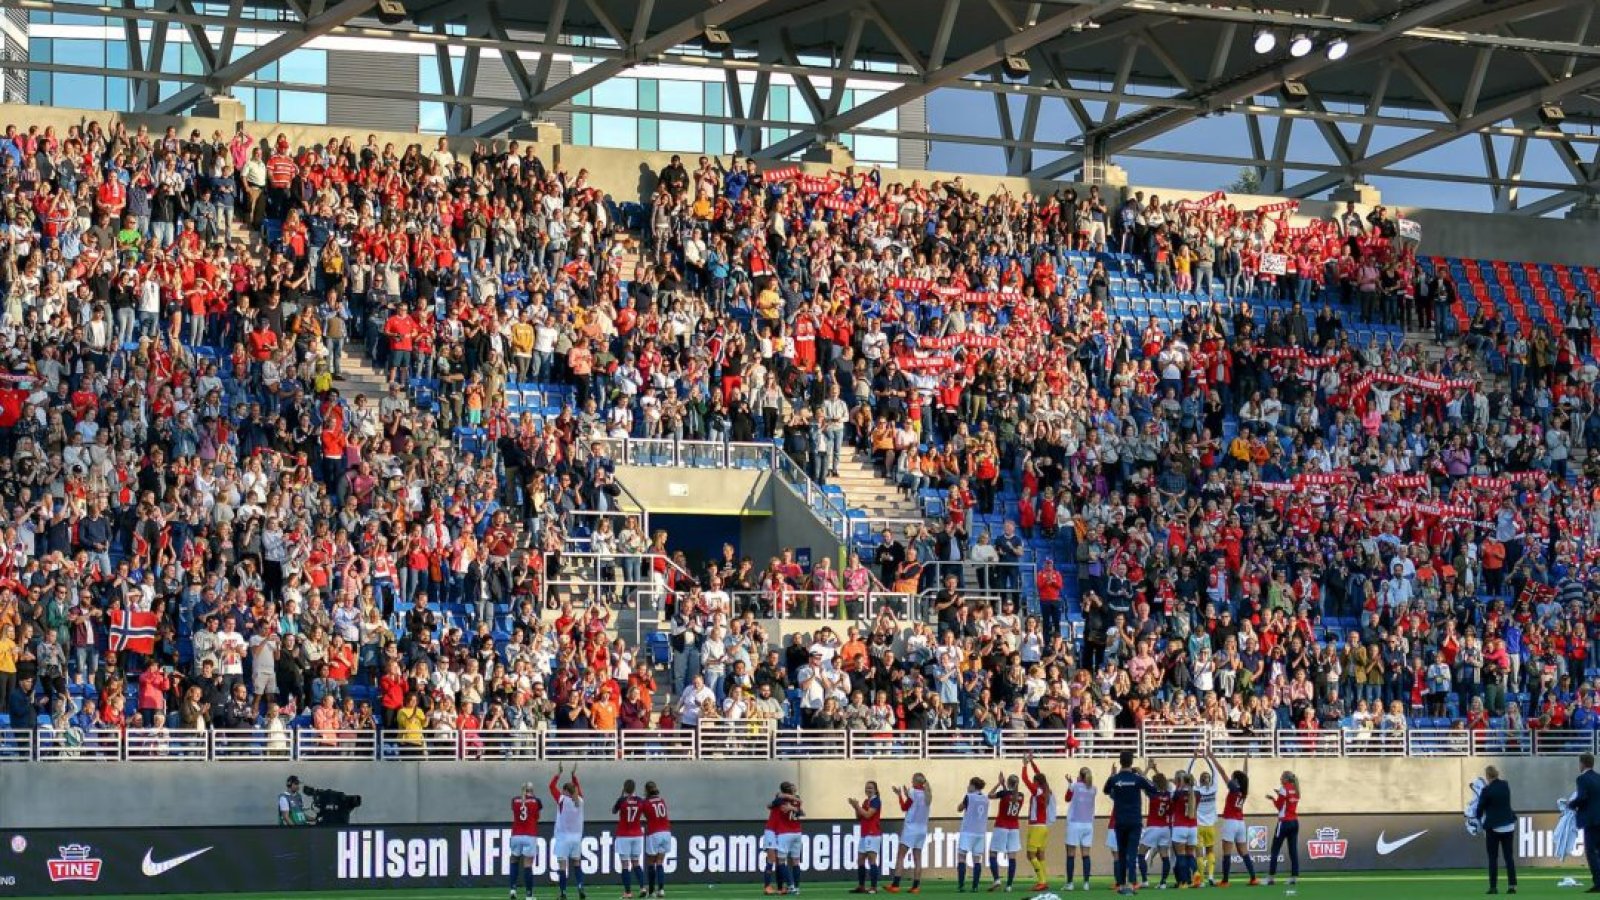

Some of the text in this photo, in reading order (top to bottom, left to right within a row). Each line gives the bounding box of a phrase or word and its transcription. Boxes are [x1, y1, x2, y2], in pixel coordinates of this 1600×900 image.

[519, 804, 527, 821] 3
[626, 806, 638, 822] 17
[652, 802, 666, 818] 10
[337, 829, 448, 879] Hilsen
[1312, 843, 1342, 855] TINE
[54, 863, 94, 876] TINE
